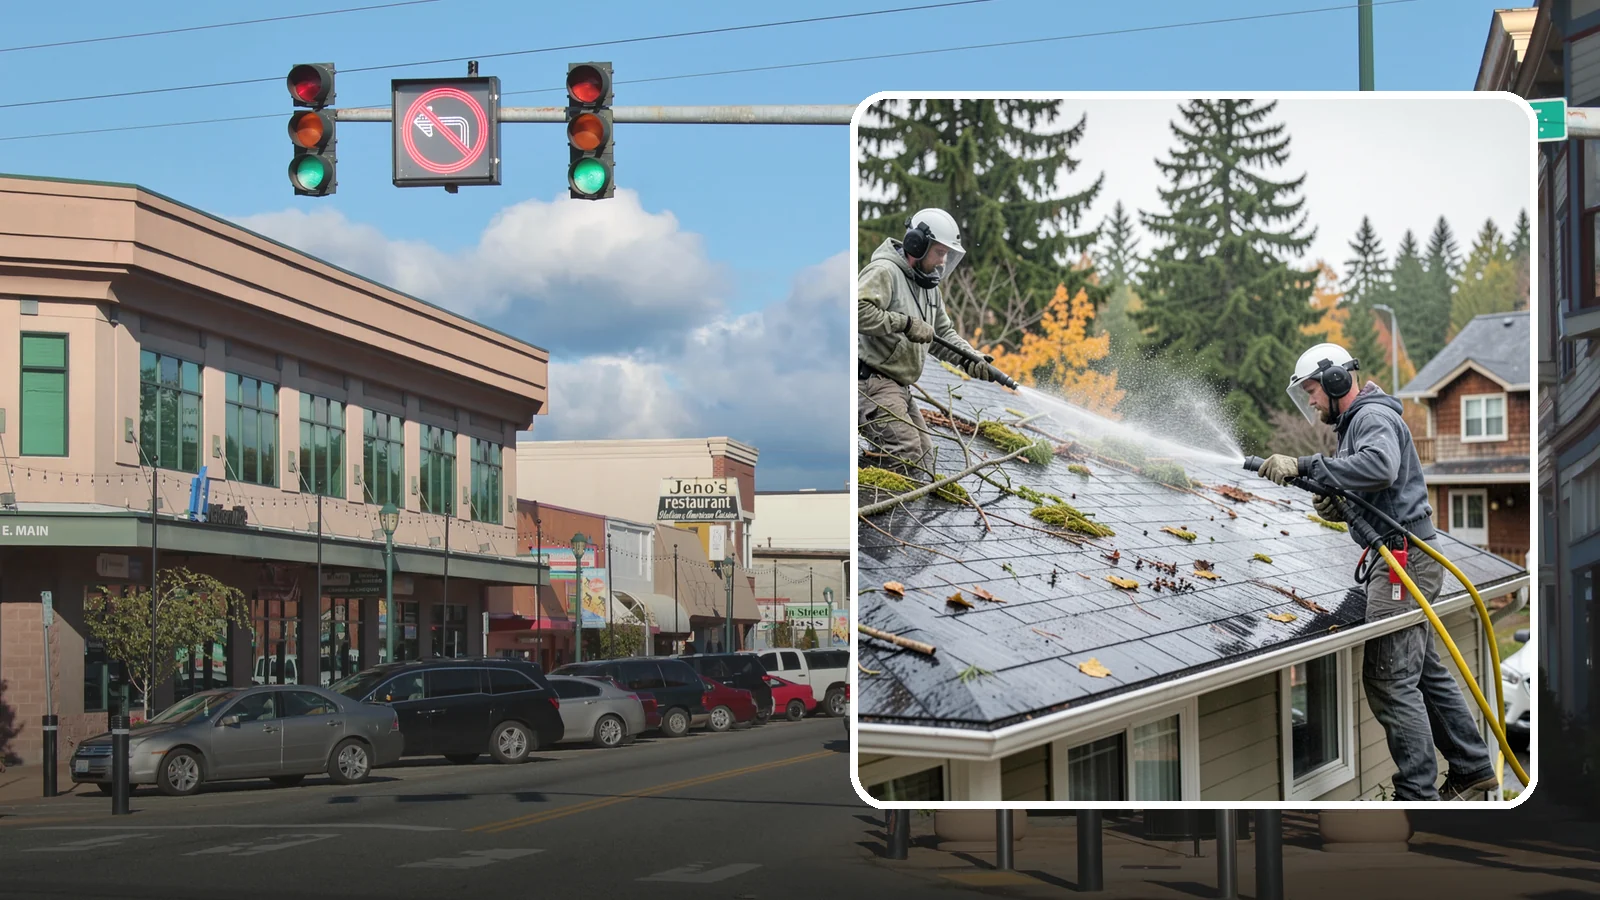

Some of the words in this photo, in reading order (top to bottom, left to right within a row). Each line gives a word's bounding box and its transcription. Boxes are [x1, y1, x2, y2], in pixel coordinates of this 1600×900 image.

[670, 480, 727, 494] Jeno's
[665, 496, 731, 509] restaurant
[658, 509, 682, 519] Italian
[686, 510, 714, 519] American
[715, 510, 737, 519] Cuisine
[2, 525, 13, 536] E.
[15, 525, 49, 536] MAIN
[785, 607, 795, 617] in
[797, 607, 828, 617] Street
